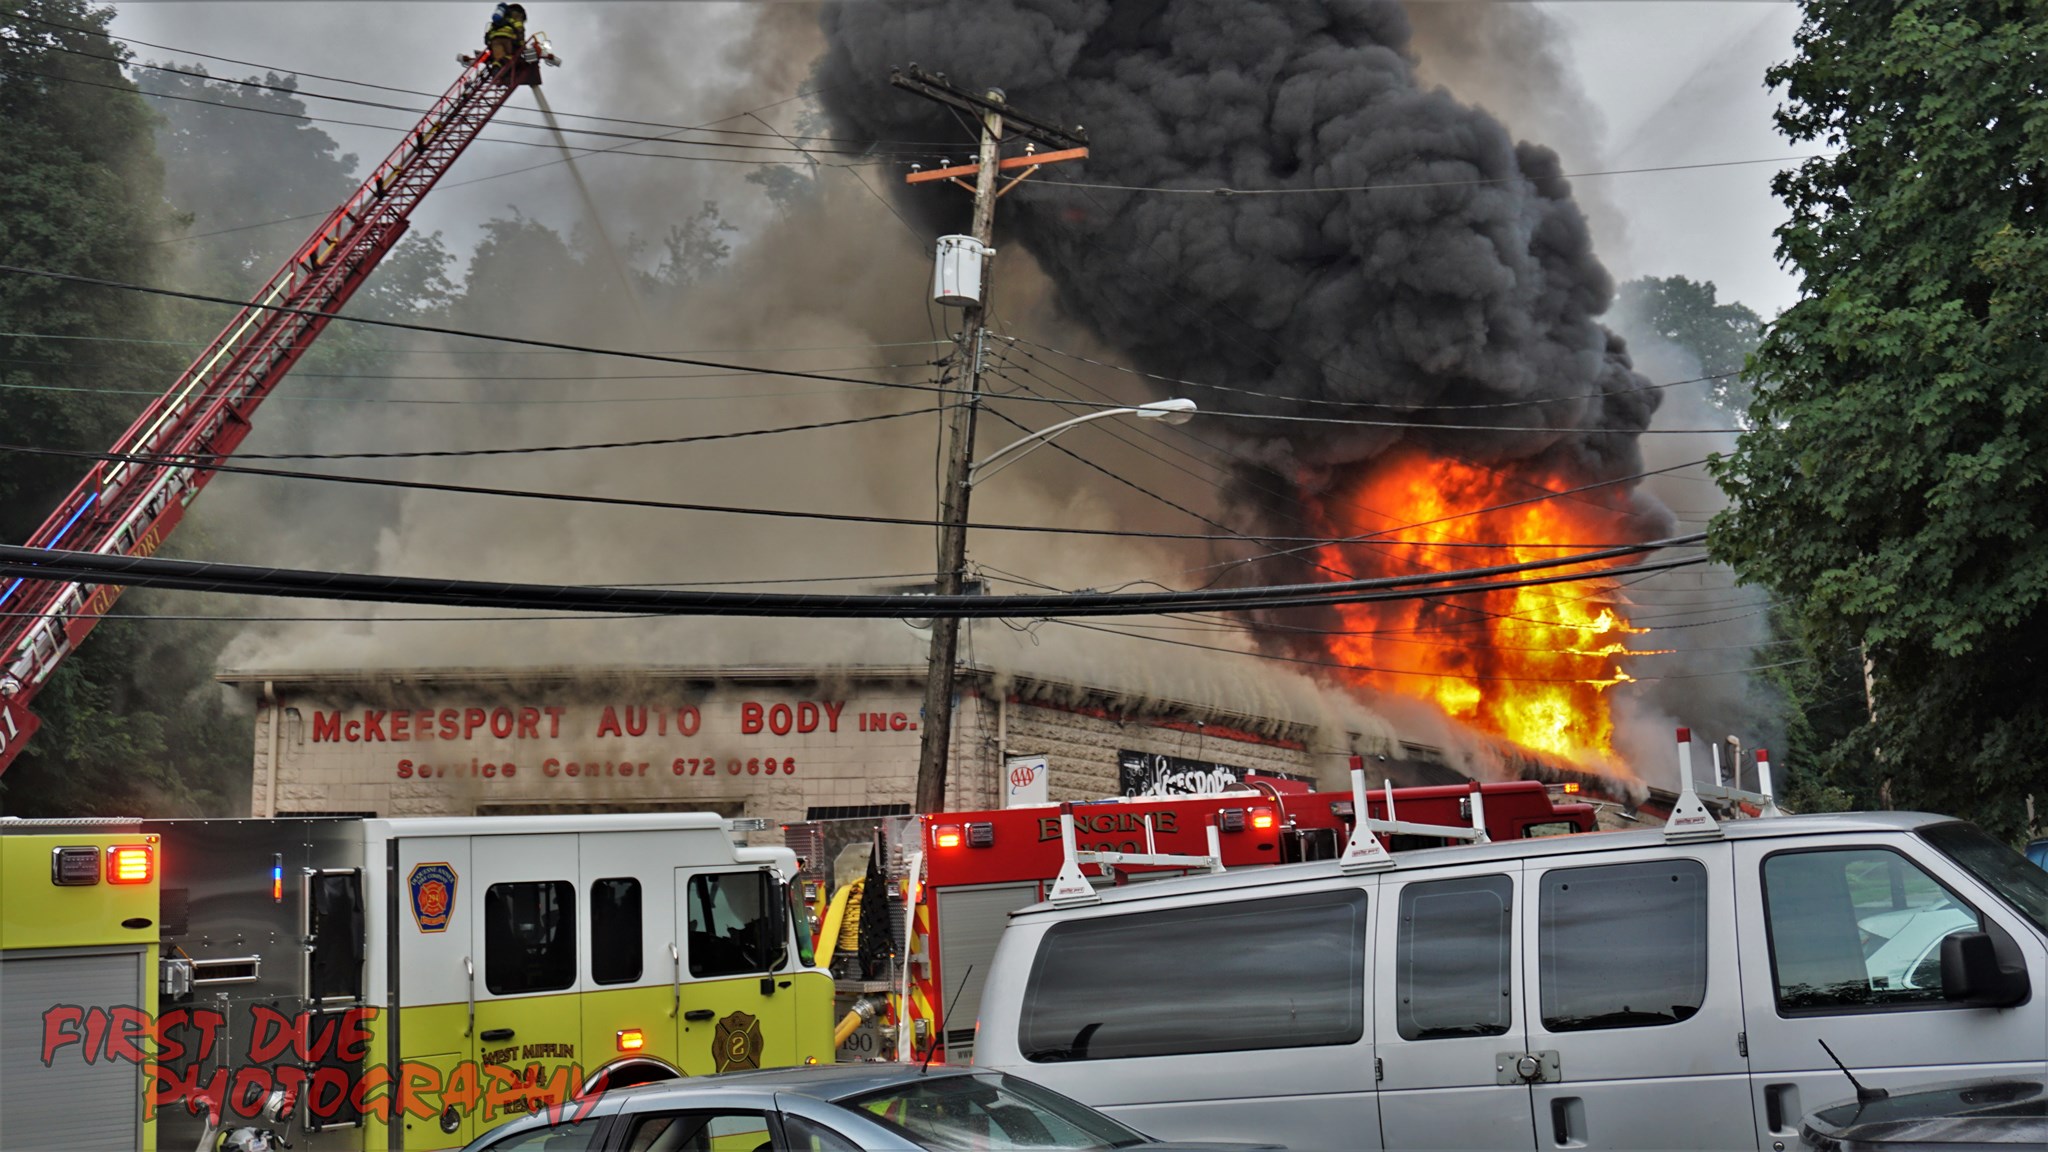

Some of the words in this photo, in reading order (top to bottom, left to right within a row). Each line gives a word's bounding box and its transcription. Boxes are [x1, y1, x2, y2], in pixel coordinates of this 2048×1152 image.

[312, 706, 566, 742] McKEESPORT
[597, 704, 701, 737] AUTO
[741, 701, 845, 736] BODY
[858, 711, 917, 732] INC.
[396, 758, 517, 779] Service
[542, 757, 650, 778] Center
[672, 757, 716, 777] 672
[727, 757, 796, 776] 0696
[1012, 767, 1033, 787] AAA
[1037, 811, 1179, 842] ENGINE
[482, 1046, 519, 1065] WEST
[522, 1043, 574, 1059] MIFFLIN
[732, 1036, 745, 1055] 2
